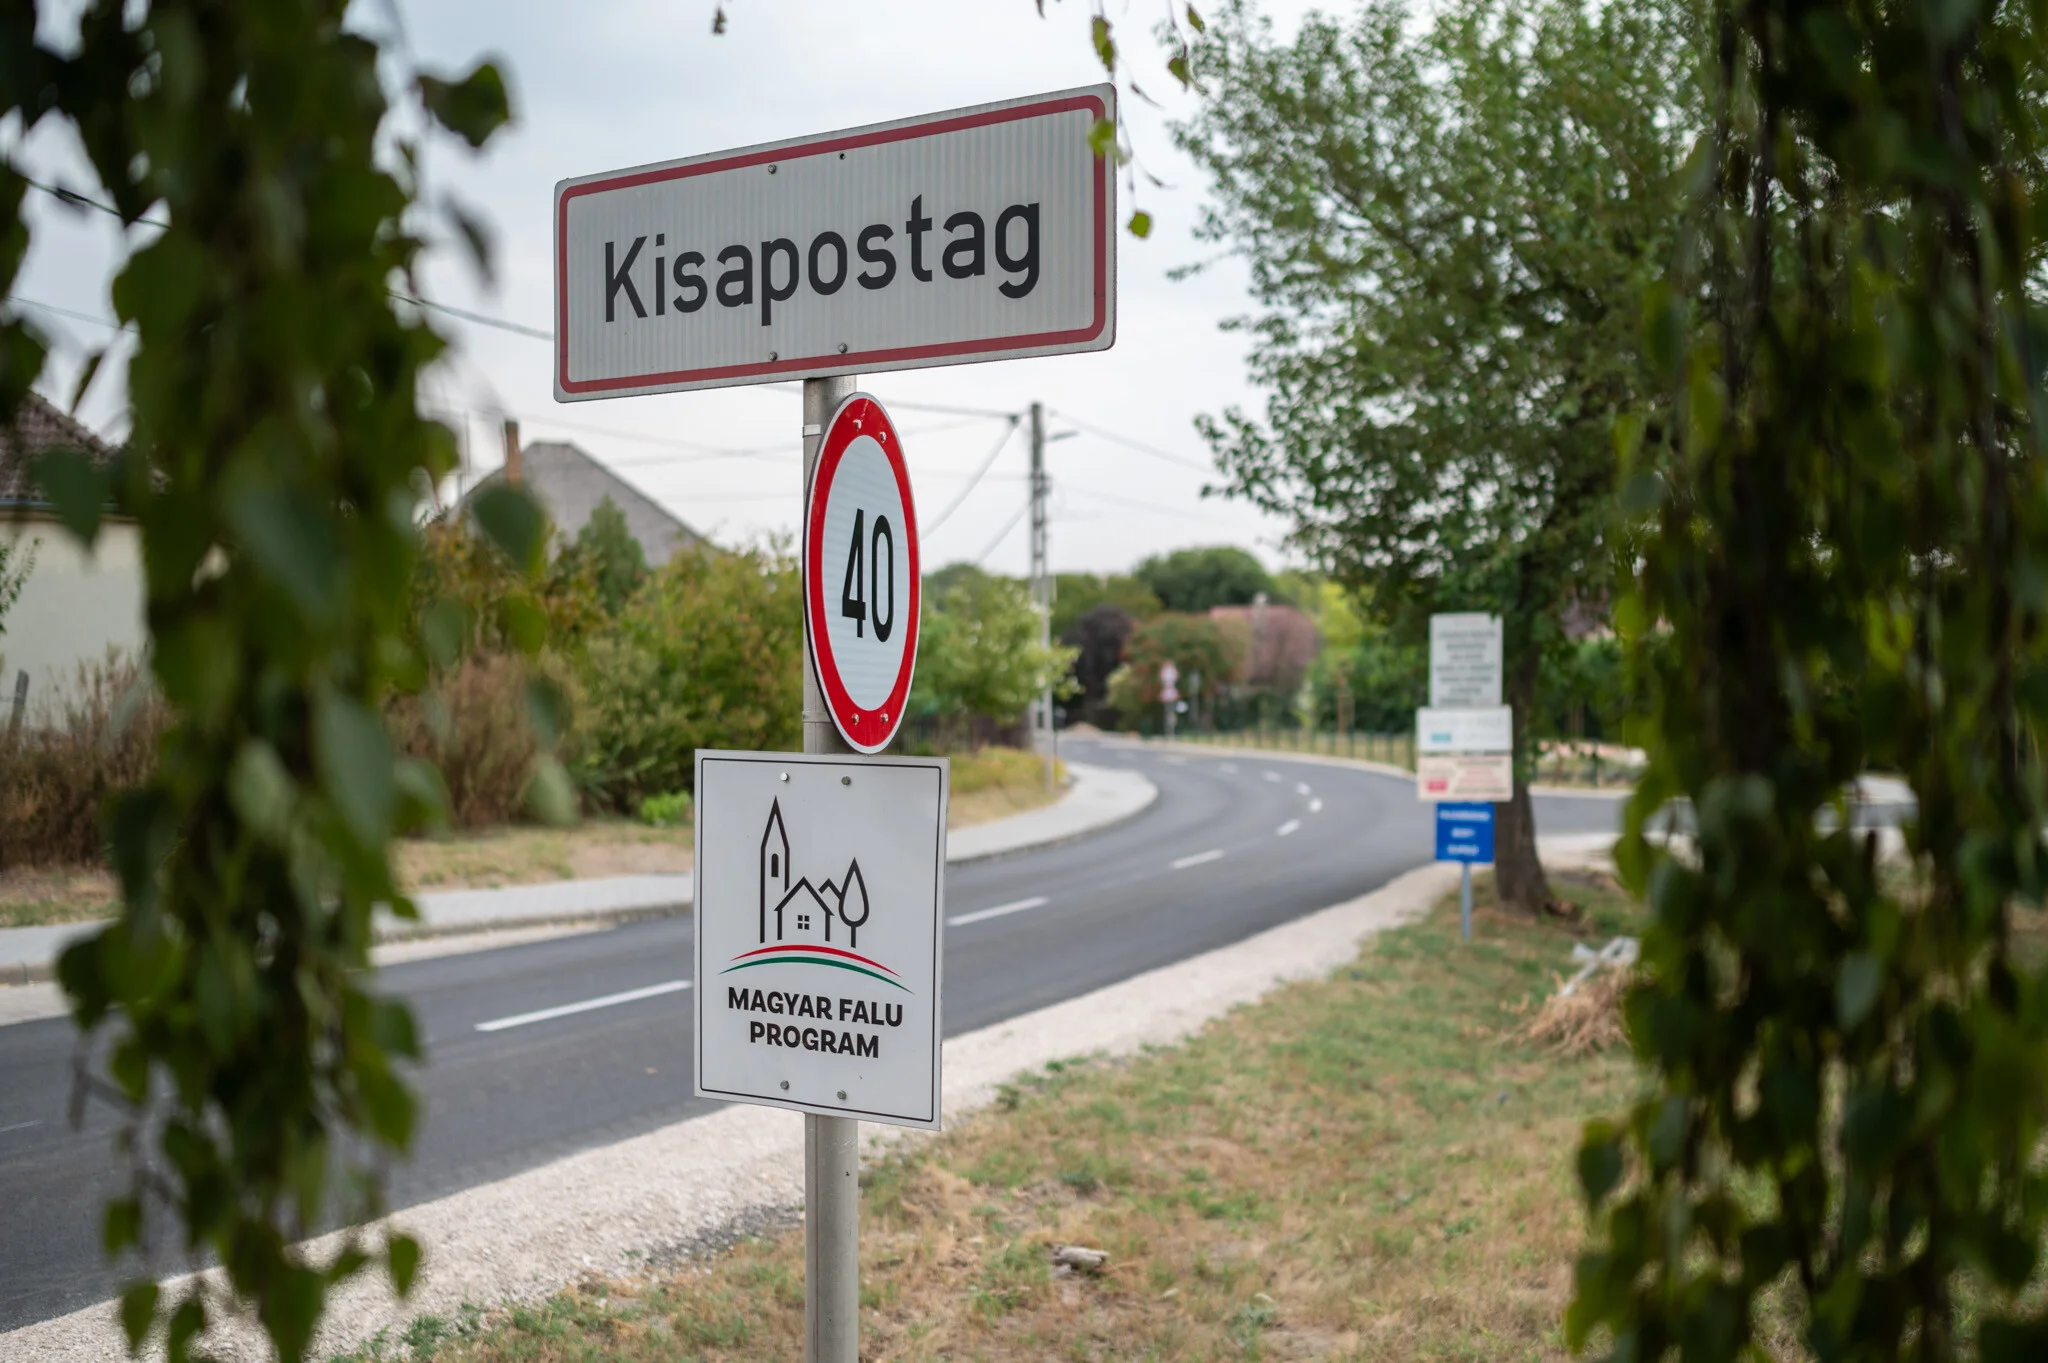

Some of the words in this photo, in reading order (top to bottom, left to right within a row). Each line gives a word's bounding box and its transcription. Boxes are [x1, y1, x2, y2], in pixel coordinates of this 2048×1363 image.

[605, 194, 1040, 326] Kisapostag
[842, 508, 892, 642] 40
[728, 987, 833, 1020] MAGYAR
[840, 998, 903, 1027] FALU
[750, 1021, 879, 1059] PROGRAM
